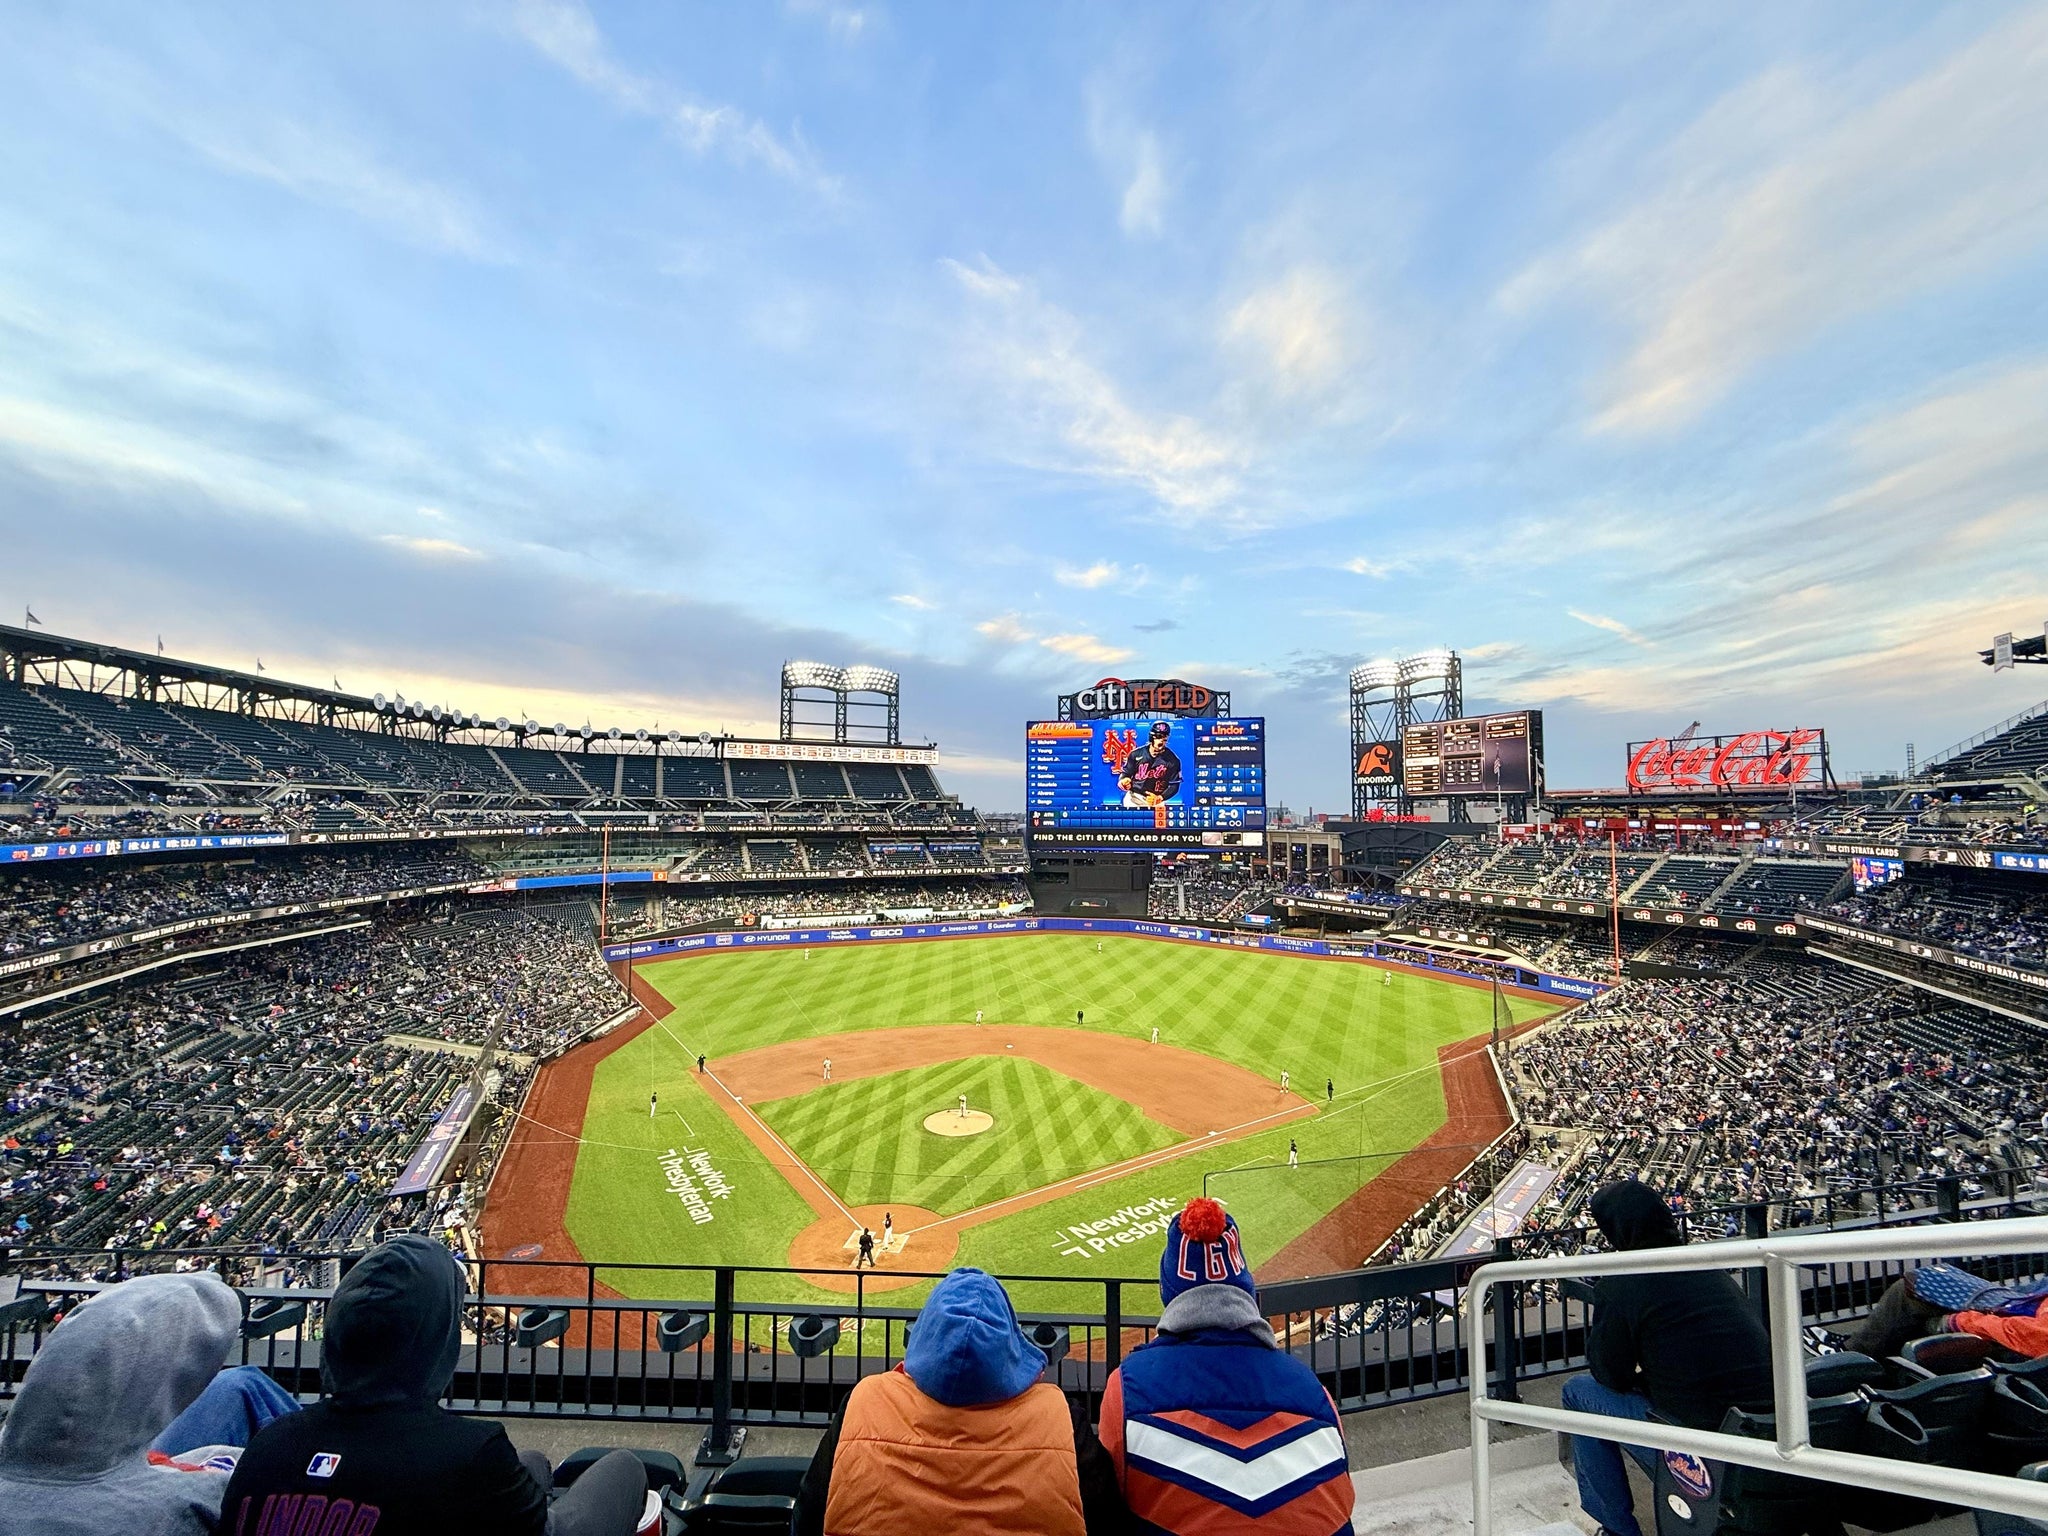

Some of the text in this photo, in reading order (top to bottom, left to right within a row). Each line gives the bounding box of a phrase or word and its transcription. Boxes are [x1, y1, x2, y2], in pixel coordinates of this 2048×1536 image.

[1077, 684, 1210, 710] citi FIELD
[1212, 726, 1244, 734] Lindor
[1628, 728, 1822, 787] Coca-Cola
[1357, 776, 1394, 784] moomoo
[1218, 809, 1238, 819] 2-0
[70, 844, 76, 855] 0
[95, 843, 100, 853] 0
[1851, 846, 1874, 855] STRATA
[1876, 848, 1899, 857] CARDS
[1460, 893, 1471, 901] citi
[1481, 895, 1493, 903] citi
[1503, 897, 1516, 906] citi
[1527, 900, 1541, 908] citi
[1552, 902, 1566, 912] citi
[1579, 905, 1594, 914] citi
[1634, 911, 1650, 920] citi
[1666, 914, 1683, 924] citi
[1700, 917, 1718, 927] citi
[1736, 920, 1756, 931] citi
[132, 930, 160, 942] REWARDS
[161, 926, 174, 935] THAT
[175, 923, 188, 932] STEP
[227, 913, 251, 922] PLATE
[1774, 924, 1796, 935] citi
[1419, 929, 1430, 937] citi
[678, 938, 705, 948] Canon
[1273, 938, 1313, 947] HENDRICK'S
[1476, 937, 1488, 946] citi
[32, 953, 61, 966] CARDS
[1953, 956, 2048, 988] THE CITI STRATA CARDS
[1550, 979, 1593, 994] Heineken
[660, 1158, 714, 1225] Presbyterian
